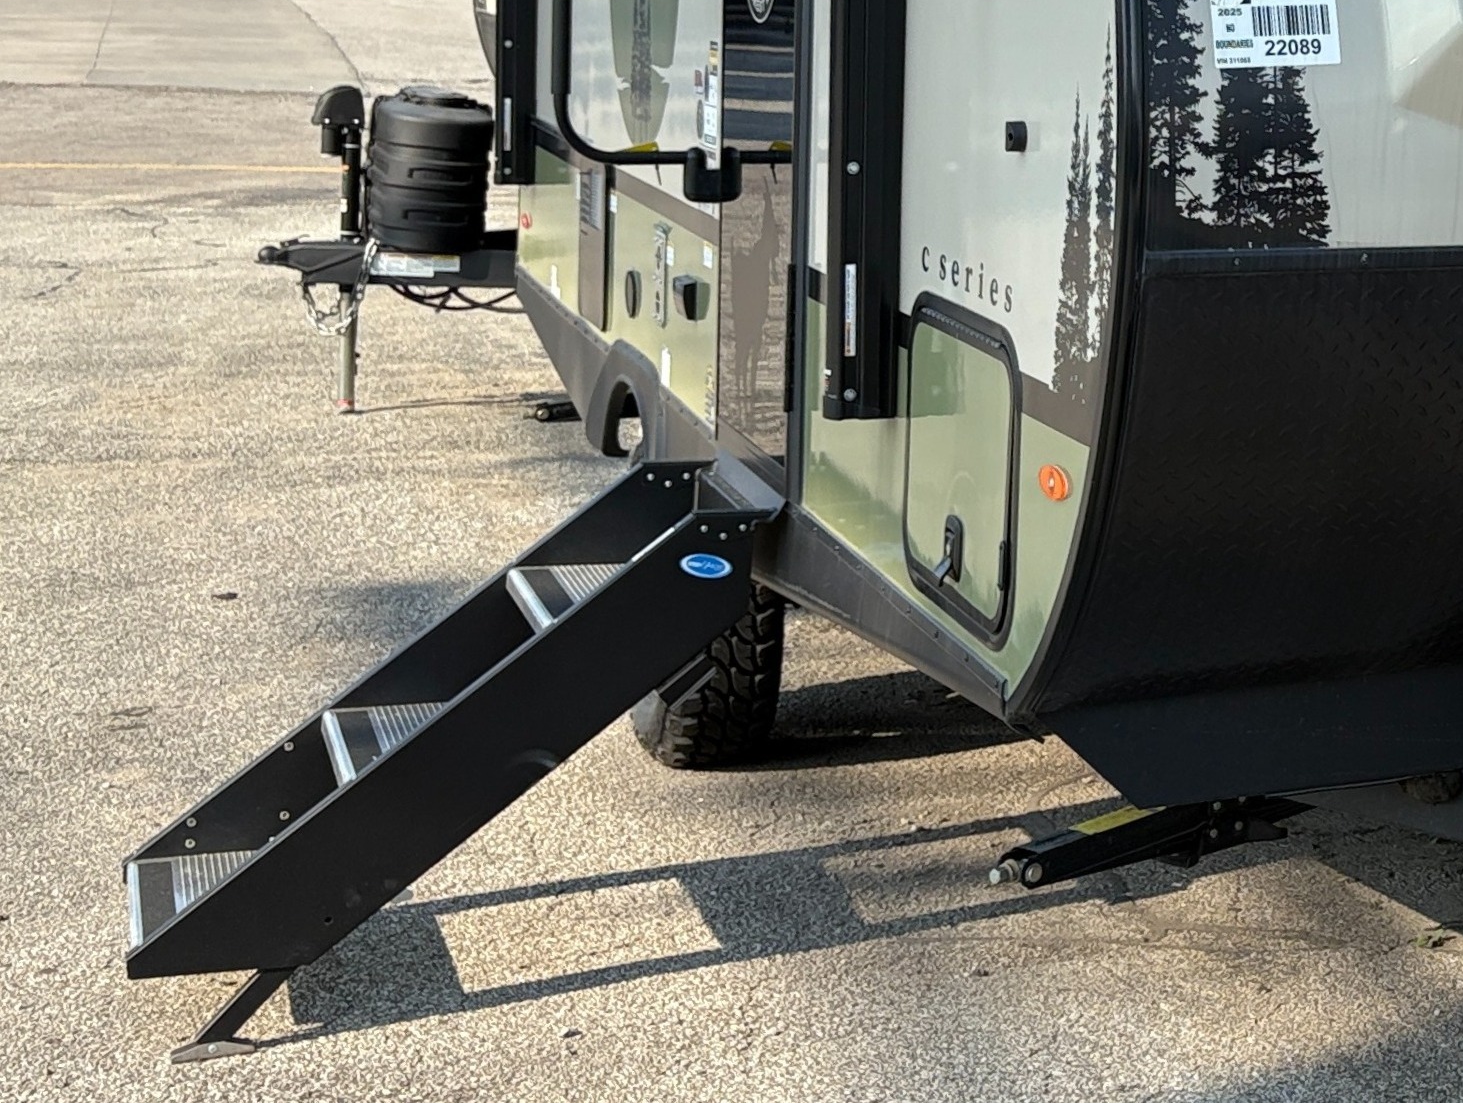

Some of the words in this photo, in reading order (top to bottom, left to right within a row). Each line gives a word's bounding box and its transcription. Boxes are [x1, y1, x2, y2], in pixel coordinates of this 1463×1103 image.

[1218, 8, 1243, 17] 2025
[1264, 39, 1322, 56] 22089
[939, 253, 1013, 313] series
